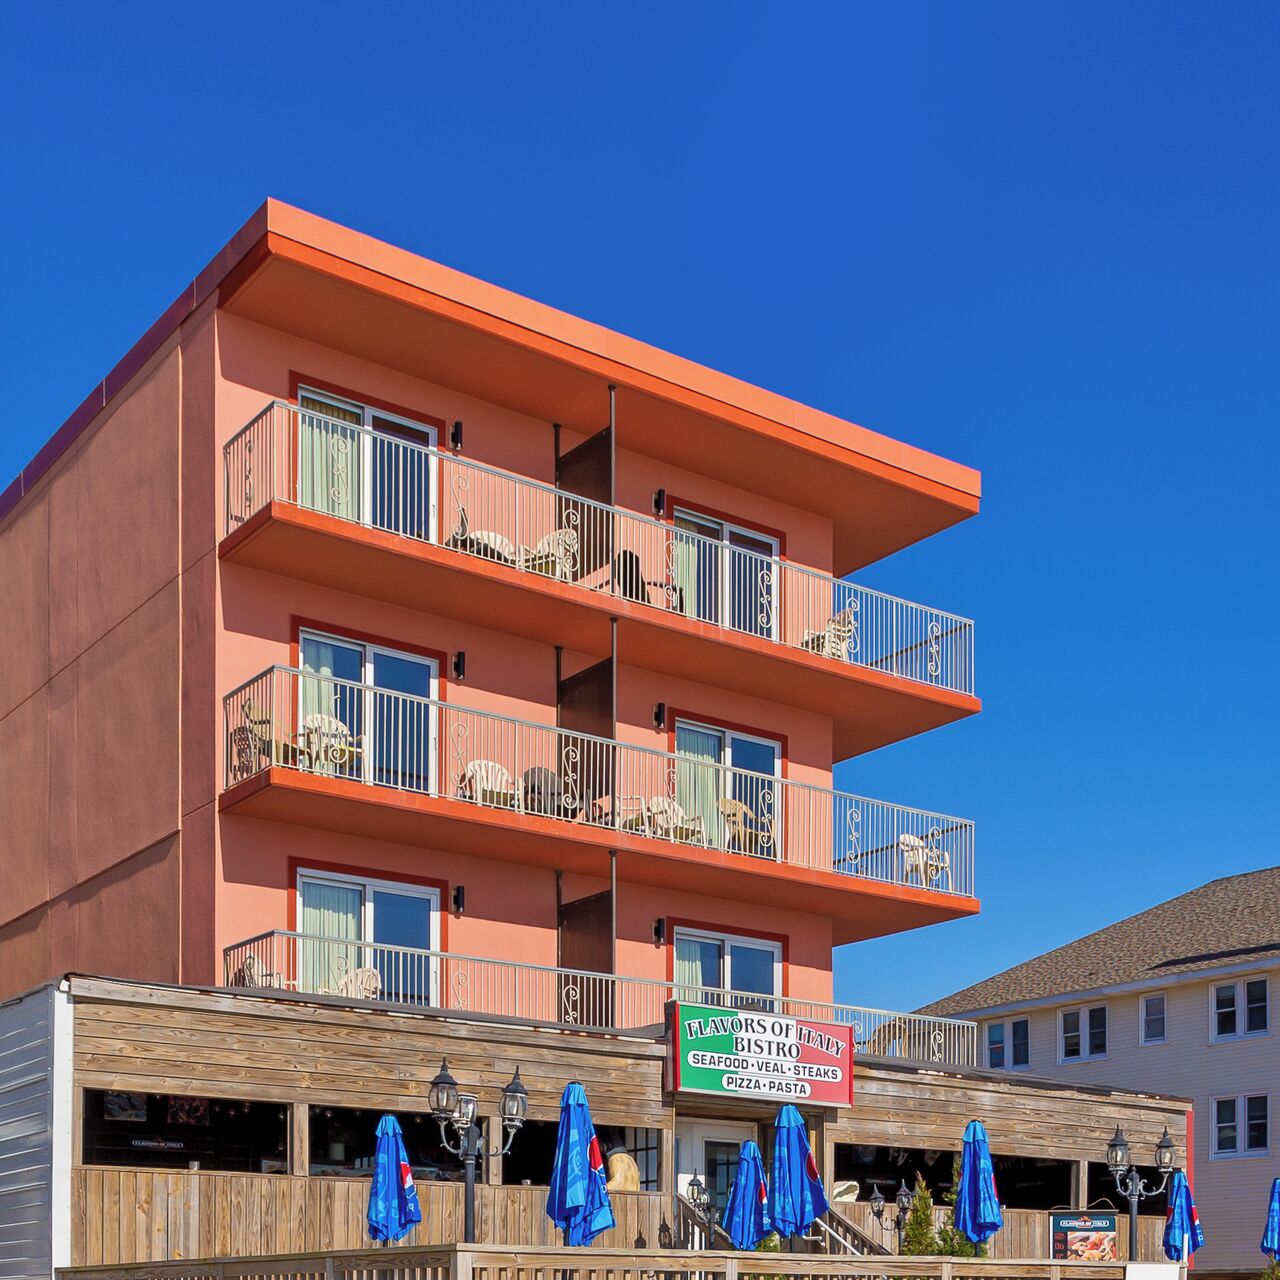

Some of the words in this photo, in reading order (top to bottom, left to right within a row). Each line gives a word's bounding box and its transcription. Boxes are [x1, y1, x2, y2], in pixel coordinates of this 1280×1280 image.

[686, 1017, 767, 1039] FLAVORS
[771, 1021, 795, 1038] OF
[797, 1026, 846, 1058] ITALY
[733, 1036, 801, 1059] BISTRO
[692, 1053, 749, 1070] SEAFOOD
[756, 1060, 786, 1074] VEAL
[793, 1065, 838, 1080] STEAKS
[726, 1076, 761, 1090] PIZZA
[769, 1081, 807, 1095] PASTA
